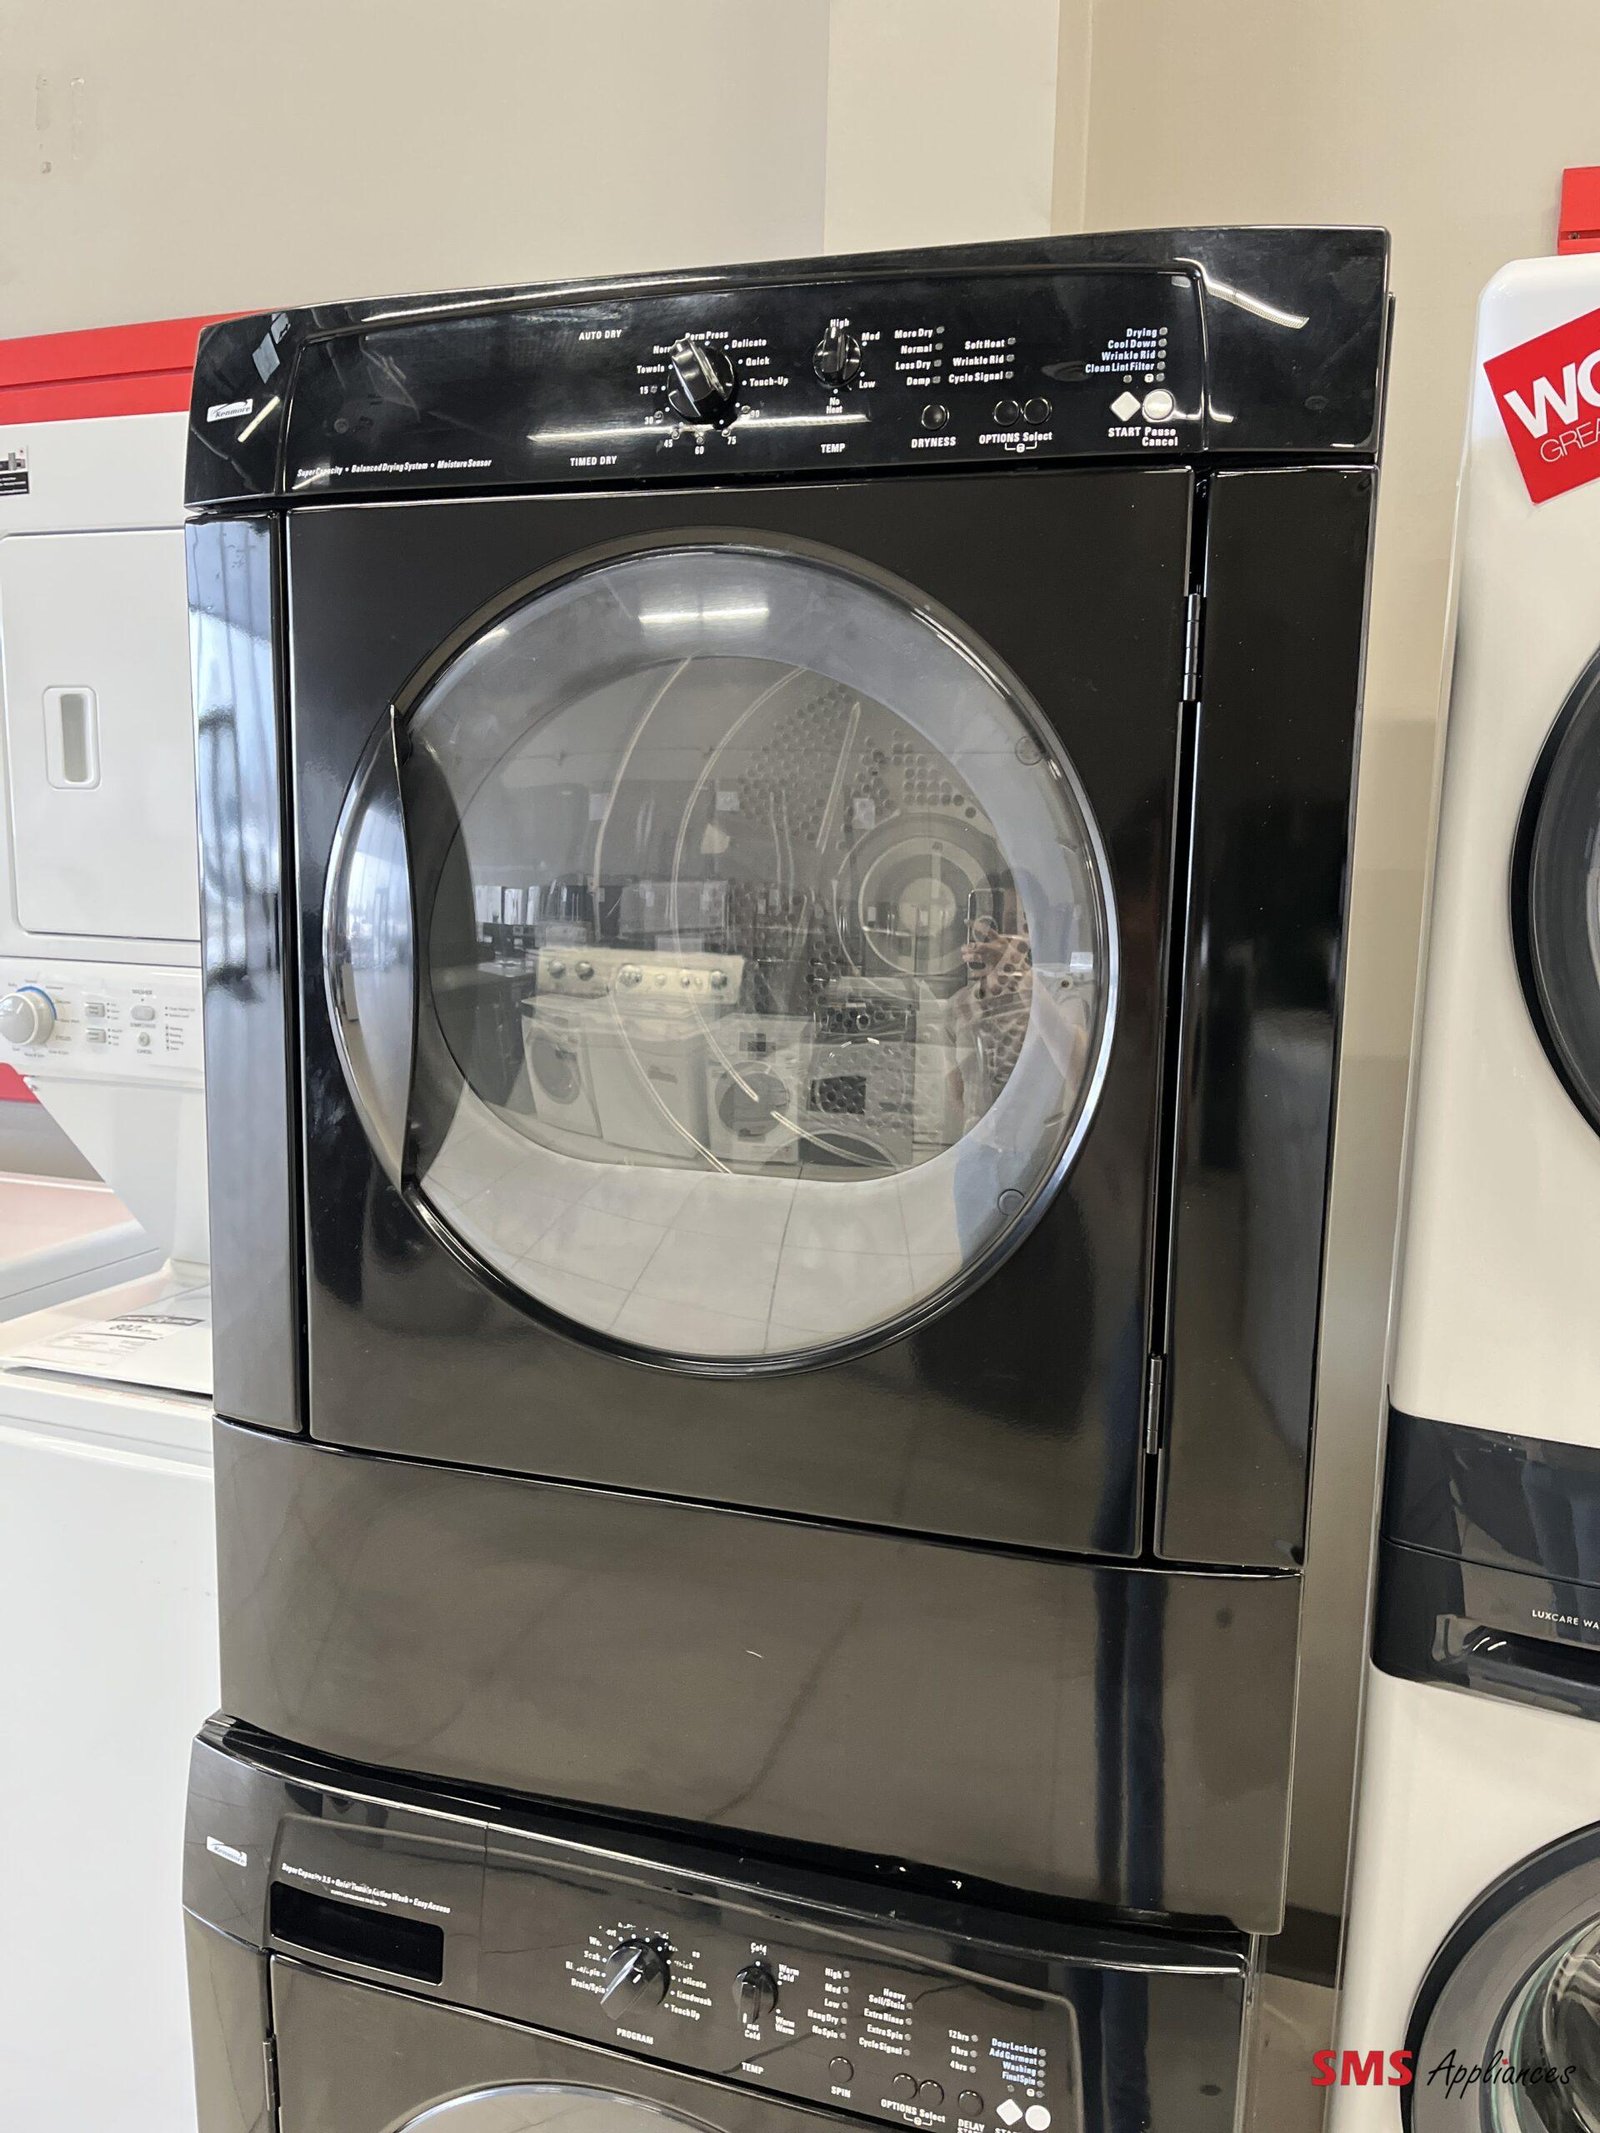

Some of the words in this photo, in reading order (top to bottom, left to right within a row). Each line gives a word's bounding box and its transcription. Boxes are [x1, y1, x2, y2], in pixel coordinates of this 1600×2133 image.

[830, 318, 850, 329] High
[579, 330, 602, 341] AUTO
[604, 329, 622, 340] DRY
[685, 332, 705, 341] Perm
[706, 331, 729, 340] Press
[862, 332, 880, 341] Med
[894, 330, 916, 339] More
[918, 328, 934, 339] Dry
[1126, 328, 1158, 338] Drying
[732, 338, 767, 349] Delicate
[900, 344, 932, 354] Normal
[964, 340, 984, 350] Soft
[984, 339, 1005, 349] Heat
[1108, 340, 1129, 349] Cool
[1130, 339, 1156, 348] Down
[746, 356, 770, 366] Quick
[953, 356, 988, 367] Wrinkle
[989, 355, 1004, 365] Rid
[1102, 350, 1138, 361] Wrinkle
[1140, 350, 1156, 360] Rid
[637, 364, 665, 374] Towels
[896, 361, 915, 370] Less
[916, 360, 932, 370] Dry
[1085, 364, 1110, 373] Clean
[1112, 362, 1128, 372] Lint
[1130, 361, 1154, 371] Filter
[750, 377, 788, 388] Touch-Up
[906, 376, 930, 387] Damp
[949, 374, 974, 384] Cycle
[974, 371, 1004, 383] Signal
[859, 380, 876, 388] Low
[640, 386, 648, 394] 15
[830, 398, 840, 406] No
[750, 410, 760, 418] 90
[826, 406, 843, 414] Heat
[644, 416, 654, 425] 30
[1108, 427, 1142, 437] START
[1144, 427, 1176, 437] Pause
[664, 439, 673, 448] 45
[727, 436, 736, 445] 75
[911, 437, 956, 448] DRYNESS
[978, 433, 1020, 445] OPTIONS
[1022, 431, 1053, 442] Select
[1142, 436, 1178, 447] Cancel
[695, 446, 704, 455] 60
[821, 444, 845, 454] TEMP
[351, 463, 382, 473] Balanced
[382, 463, 404, 473] Drying
[404, 462, 428, 472] System
[437, 460, 468, 469] Moisture
[468, 458, 492, 468] Sensor
[570, 457, 598, 467] TIMED
[600, 456, 618, 466] DRY
[1532, 1610, 1579, 1626] LUXCARE
[778, 1963, 800, 1976] Warm
[824, 1968, 842, 1980] High
[778, 1972, 795, 1982] Cold
[824, 1983, 841, 1994] Med
[883, 1988, 906, 2002] Heavy
[824, 1998, 840, 2009] Low
[868, 1994, 905, 2010] Soil/Stain
[670, 2004, 690, 2016] Touch
[691, 2010, 700, 2020] Up
[808, 2008, 826, 2022] Hang
[826, 2014, 839, 2026] Dry
[864, 2008, 883, 2020] Extra
[883, 2012, 904, 2026] Rinse
[776, 2016, 795, 2028] Warm
[744, 2030, 760, 2040] Cold
[775, 2023, 795, 2036] Warm
[812, 2024, 822, 2035] No
[822, 2028, 838, 2039] Spin
[867, 2024, 886, 2036] Extra
[886, 2029, 904, 2040] Spin
[616, 2027, 654, 2045] PROGRAM
[948, 2030, 958, 2039] 12
[958, 2031, 970, 2042] hrs
[859, 2036, 879, 2050] Cycle
[879, 2042, 902, 2055] Signal
[951, 2046, 956, 2054] 8
[956, 2046, 968, 2056] hrs
[992, 2038, 1010, 2048] Door
[1010, 2042, 1038, 2055] Locked
[989, 2048, 1004, 2058] Add
[1004, 2051, 1037, 2066] Garment
[742, 2062, 764, 2074] TEMP
[950, 2060, 955, 2068] 4
[955, 2062, 968, 2072] hrs
[1002, 2061, 1036, 2076] Washing
[1002, 2070, 1020, 2083] Final
[1020, 2075, 1036, 2086] Spin
[831, 2086, 851, 2098] SPIN
[880, 2098, 918, 2116] OPTIONS
[920, 2108, 946, 2123] Select
[958, 2118, 984, 2132] DELAY
